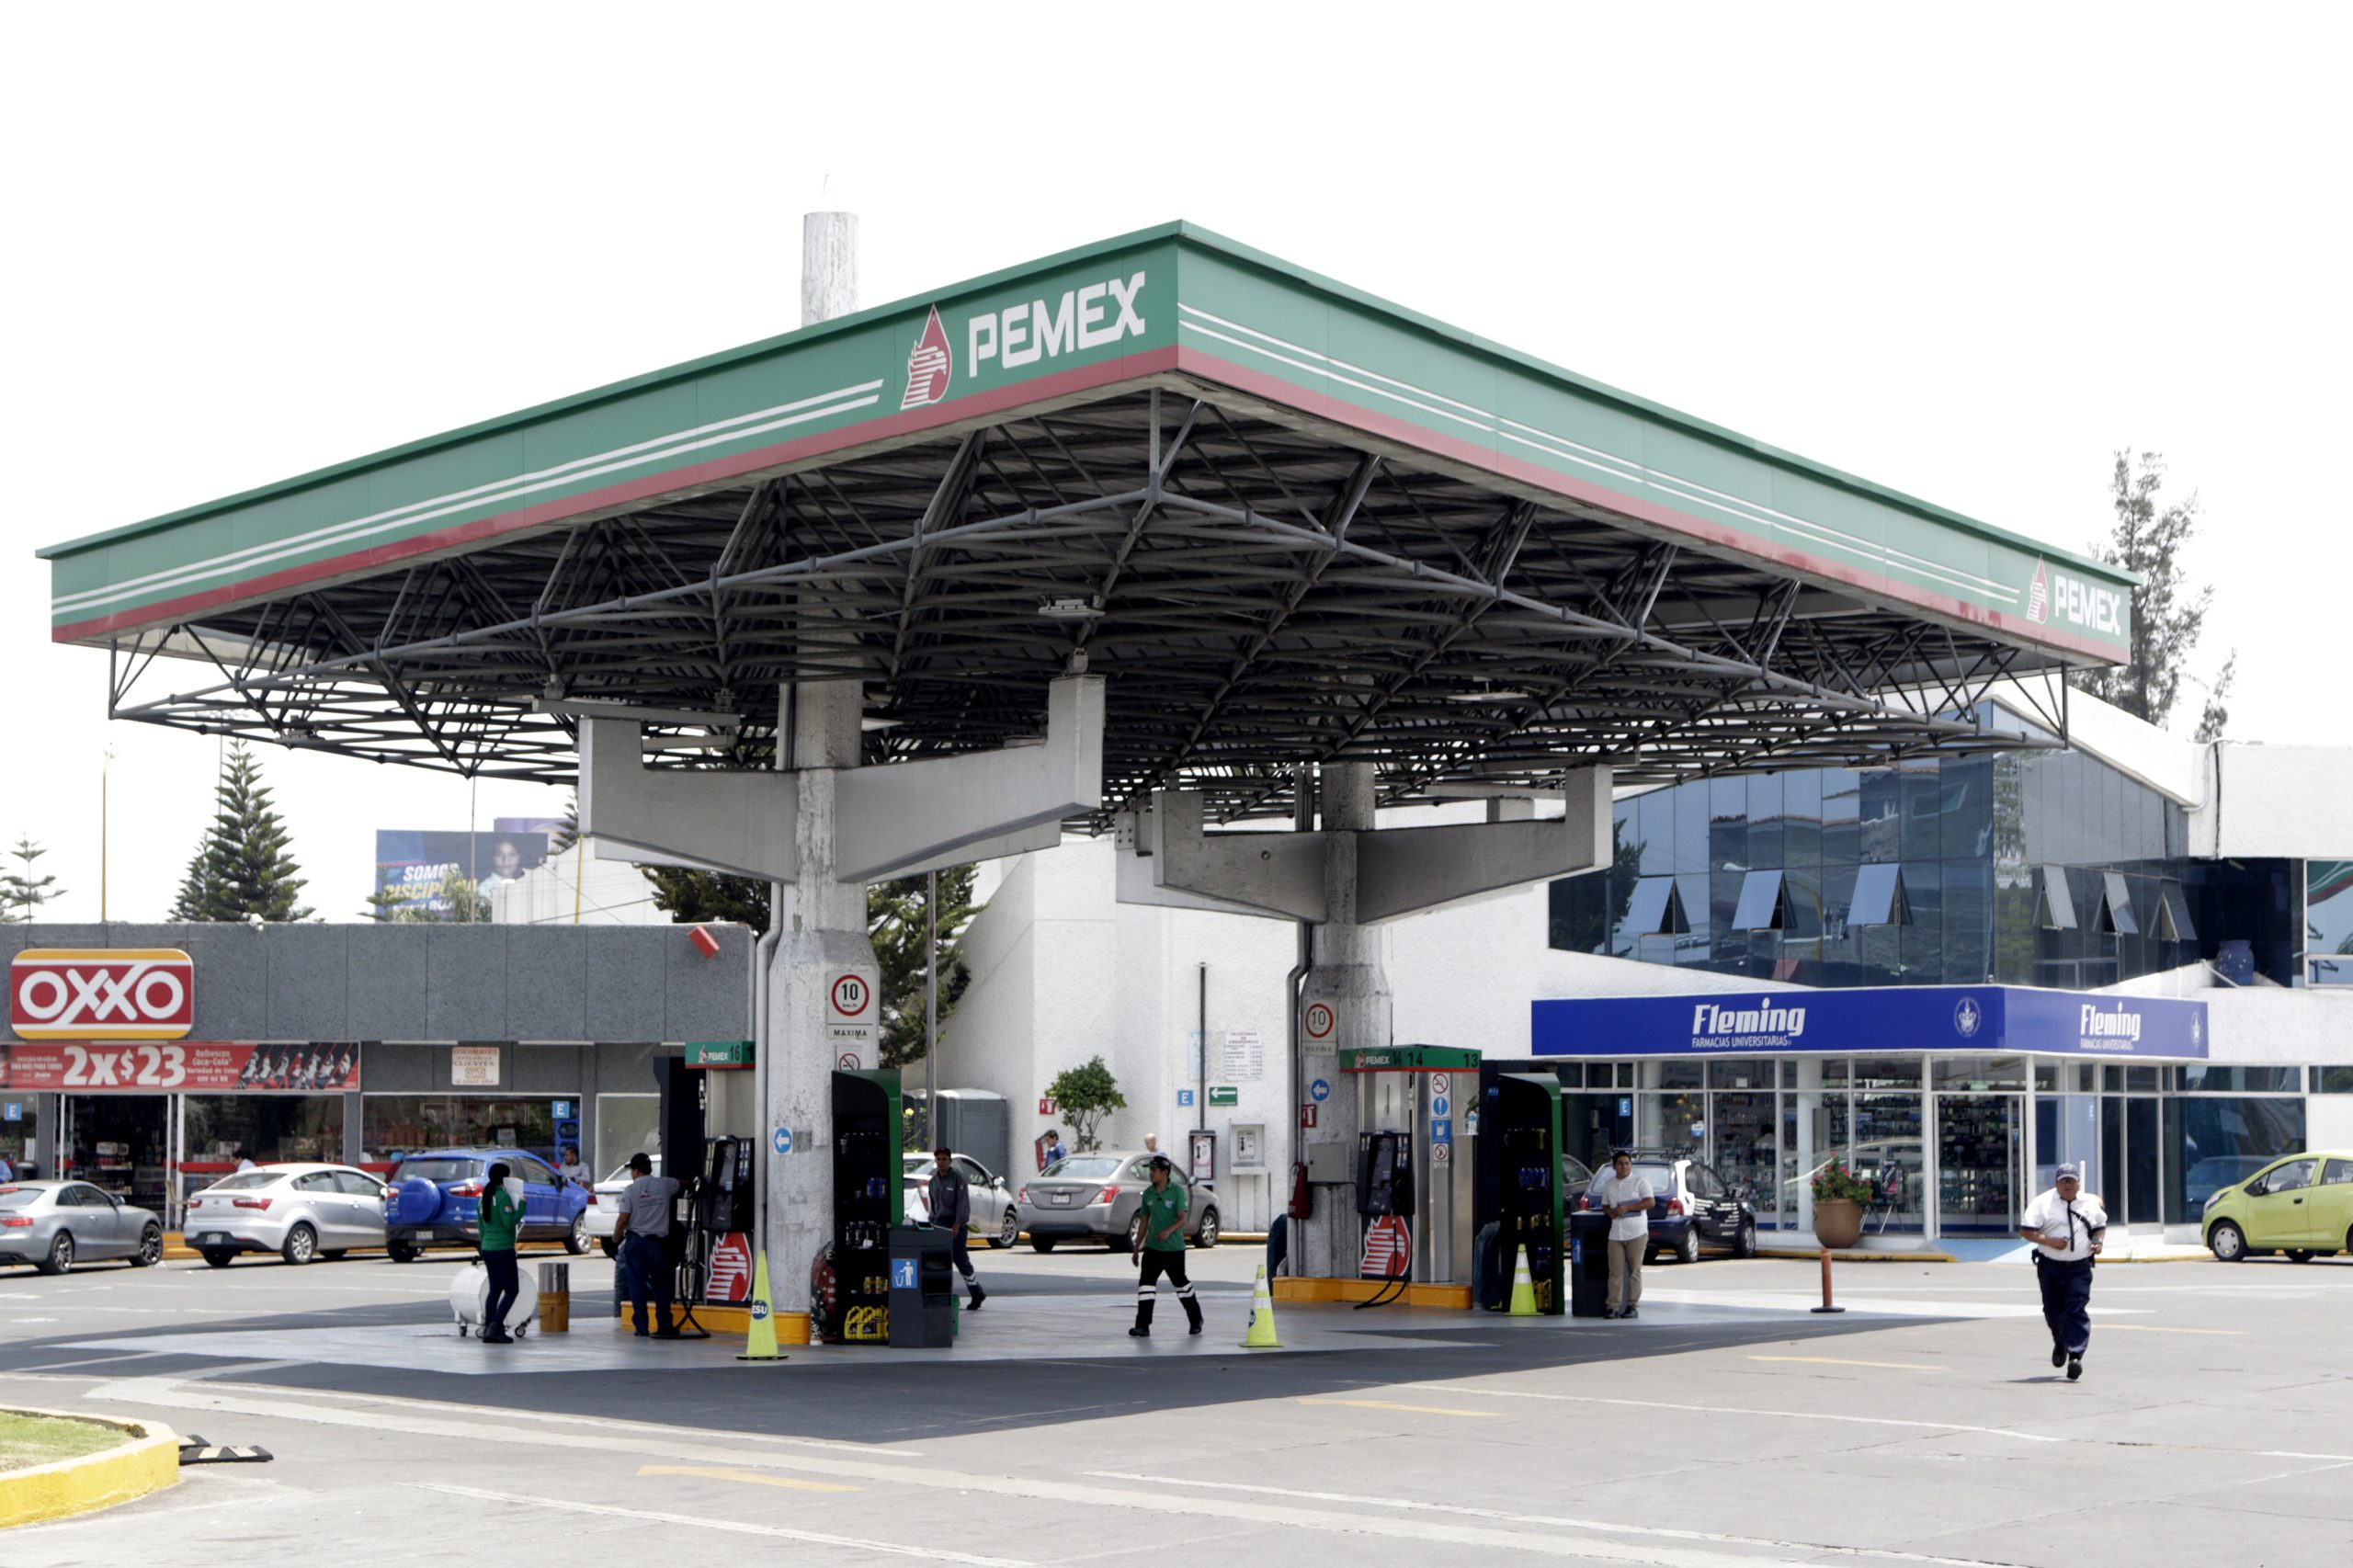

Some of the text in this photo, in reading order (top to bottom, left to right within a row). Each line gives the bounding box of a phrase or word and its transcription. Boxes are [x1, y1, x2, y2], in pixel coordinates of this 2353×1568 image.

[969, 271, 1145, 378] PEMEX
[2054, 574, 2120, 636] PEMEX
[19, 967, 185, 1023] OXXO
[842, 983, 858, 1000] 10
[1311, 1010, 1326, 1026] 10
[1692, 997, 1806, 1037] Fleming
[2080, 1001, 2142, 1040] Fleming
[1692, 1037, 1730, 1048] FARMACIAS
[708, 1045, 740, 1061] PEMEX 16
[1366, 1056, 1390, 1064] PEMEX
[1408, 1051, 1423, 1066] 14
[1463, 1053, 1478, 1067] 13
[1182, 1093, 1189, 1104] E
[9, 1105, 17, 1118] E
[557, 1103, 564, 1116] E
[1621, 1101, 1628, 1113] E
